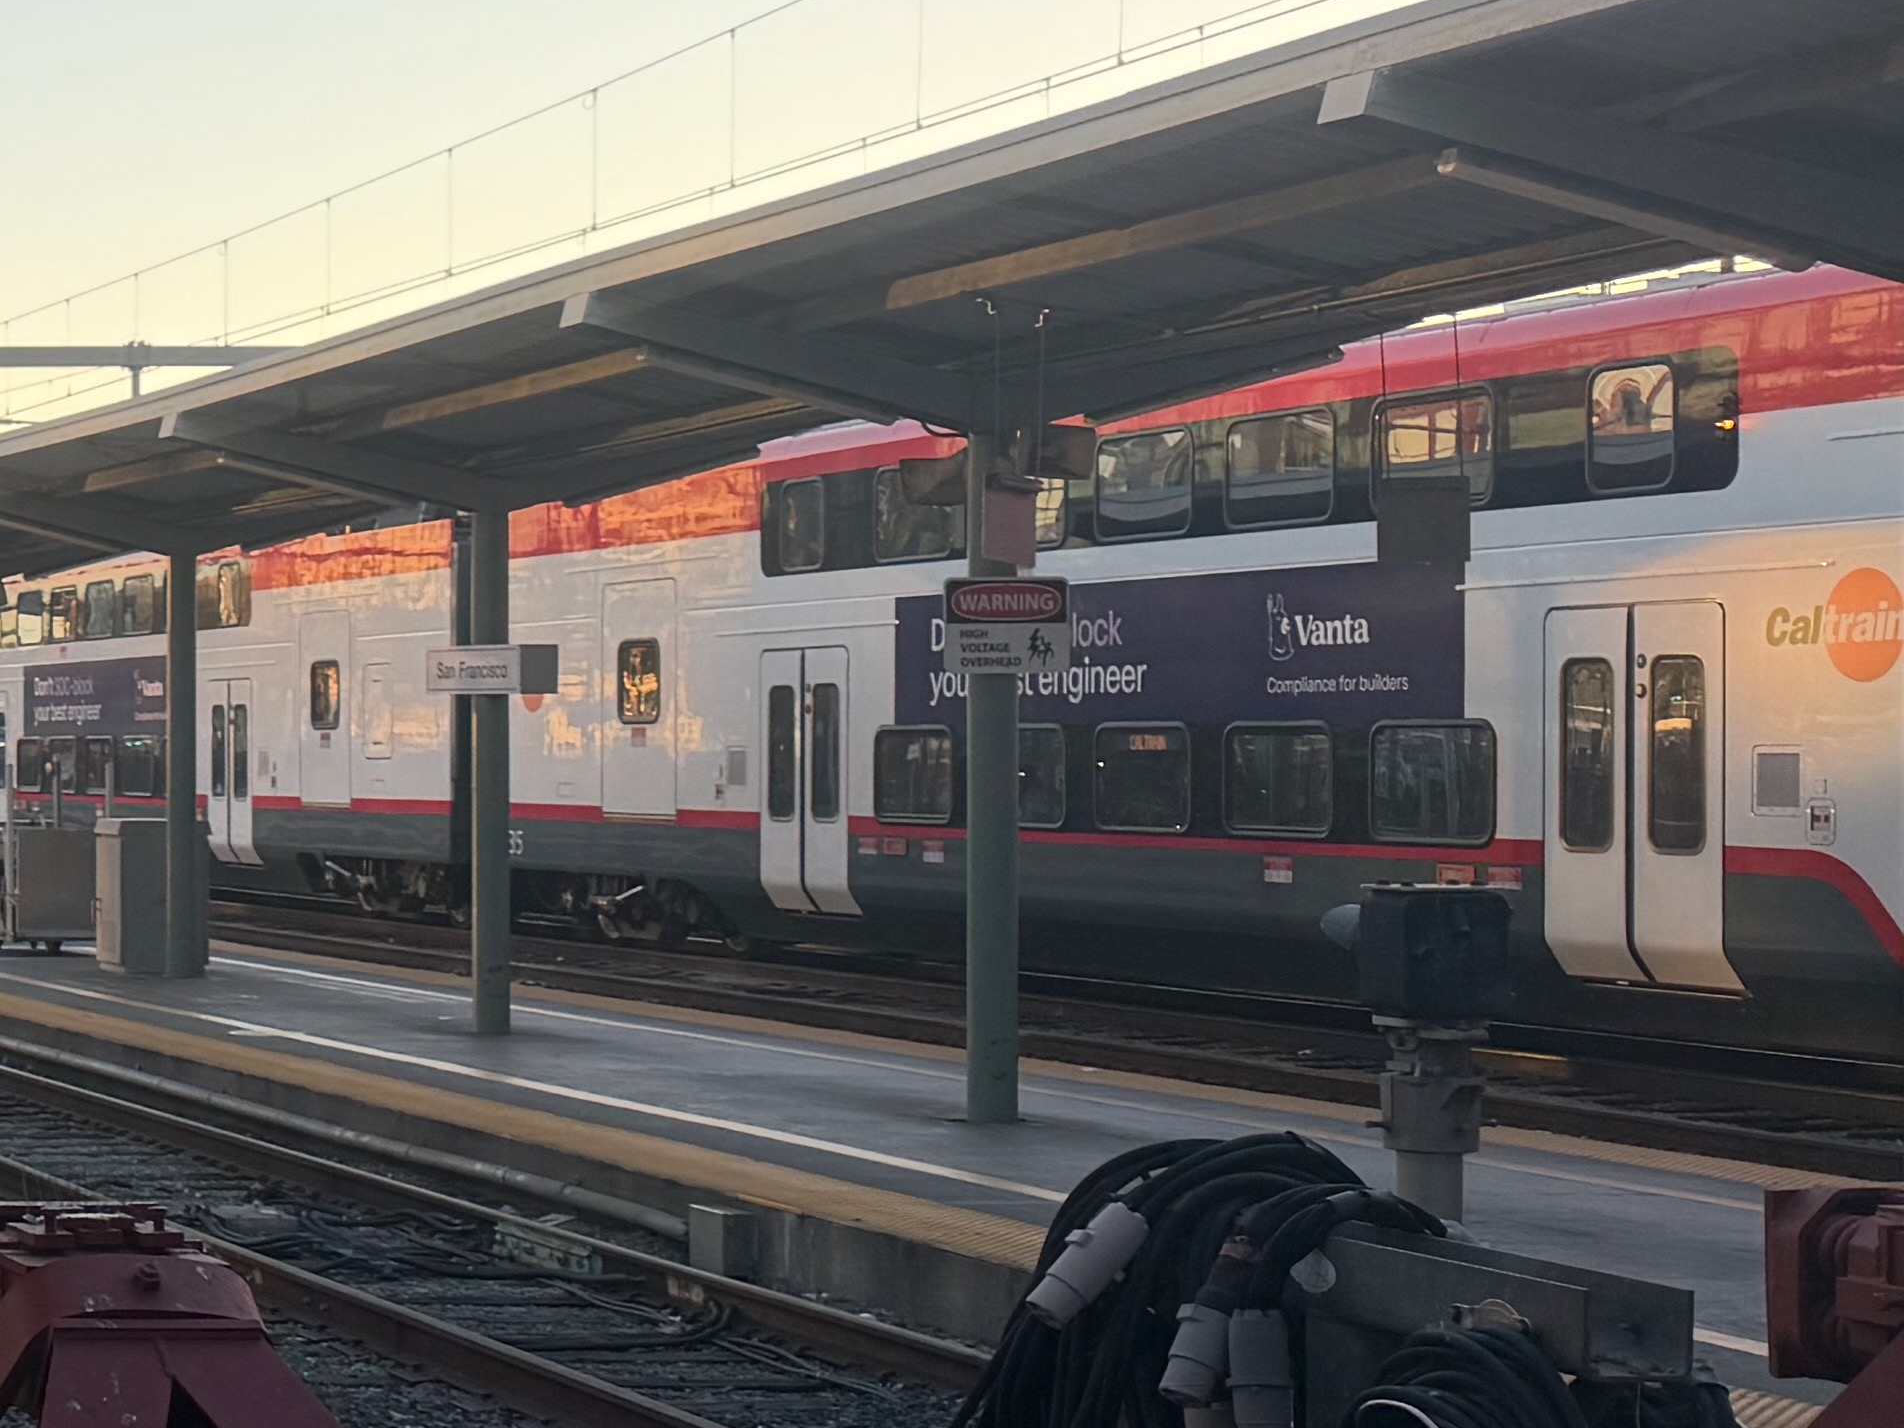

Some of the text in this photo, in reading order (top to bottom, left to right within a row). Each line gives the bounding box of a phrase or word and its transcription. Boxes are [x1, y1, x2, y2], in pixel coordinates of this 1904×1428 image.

[959, 593, 1055, 611] WARNING
[1294, 613, 1371, 646] Vanta
[1765, 600, 1904, 647] Caltrain
[959, 629, 989, 639] HIGH
[959, 643, 1010, 653] VOLTAGE
[436, 661, 508, 679] San Francisco
[959, 656, 1023, 667] OVERHEAD
[1038, 656, 1148, 703] engineer
[1266, 673, 1409, 696] Compliance for builders
